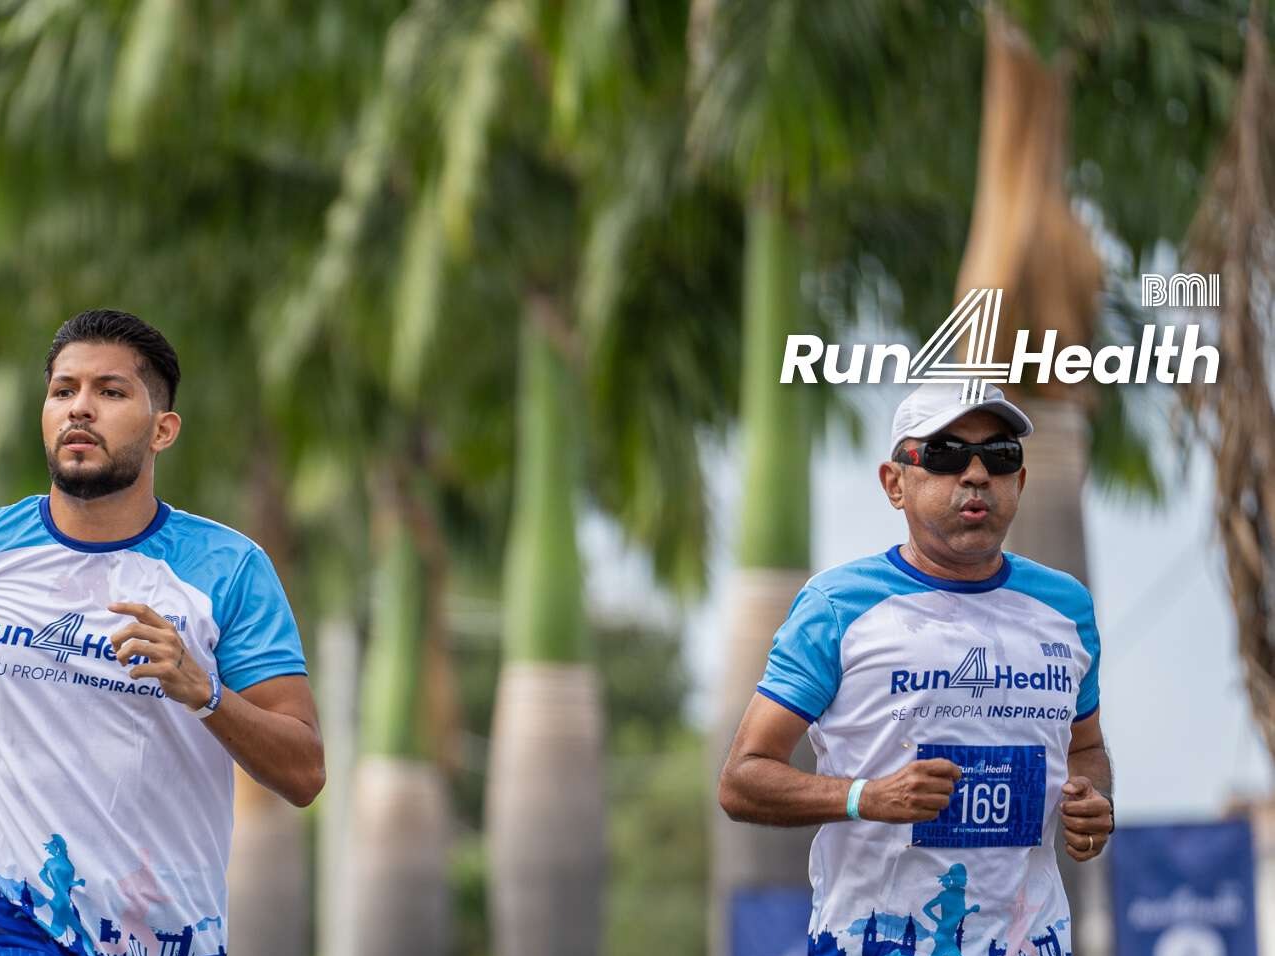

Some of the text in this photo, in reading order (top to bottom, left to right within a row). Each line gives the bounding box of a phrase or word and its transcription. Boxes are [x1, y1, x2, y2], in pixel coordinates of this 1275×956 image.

[11, 664, 68, 684] PROPIA
[890, 647, 1073, 698] Run4Health
[891, 705, 907, 721] SÉ
[912, 705, 930, 718] TU
[934, 705, 983, 719] PROPIA
[958, 783, 1012, 825] 169
